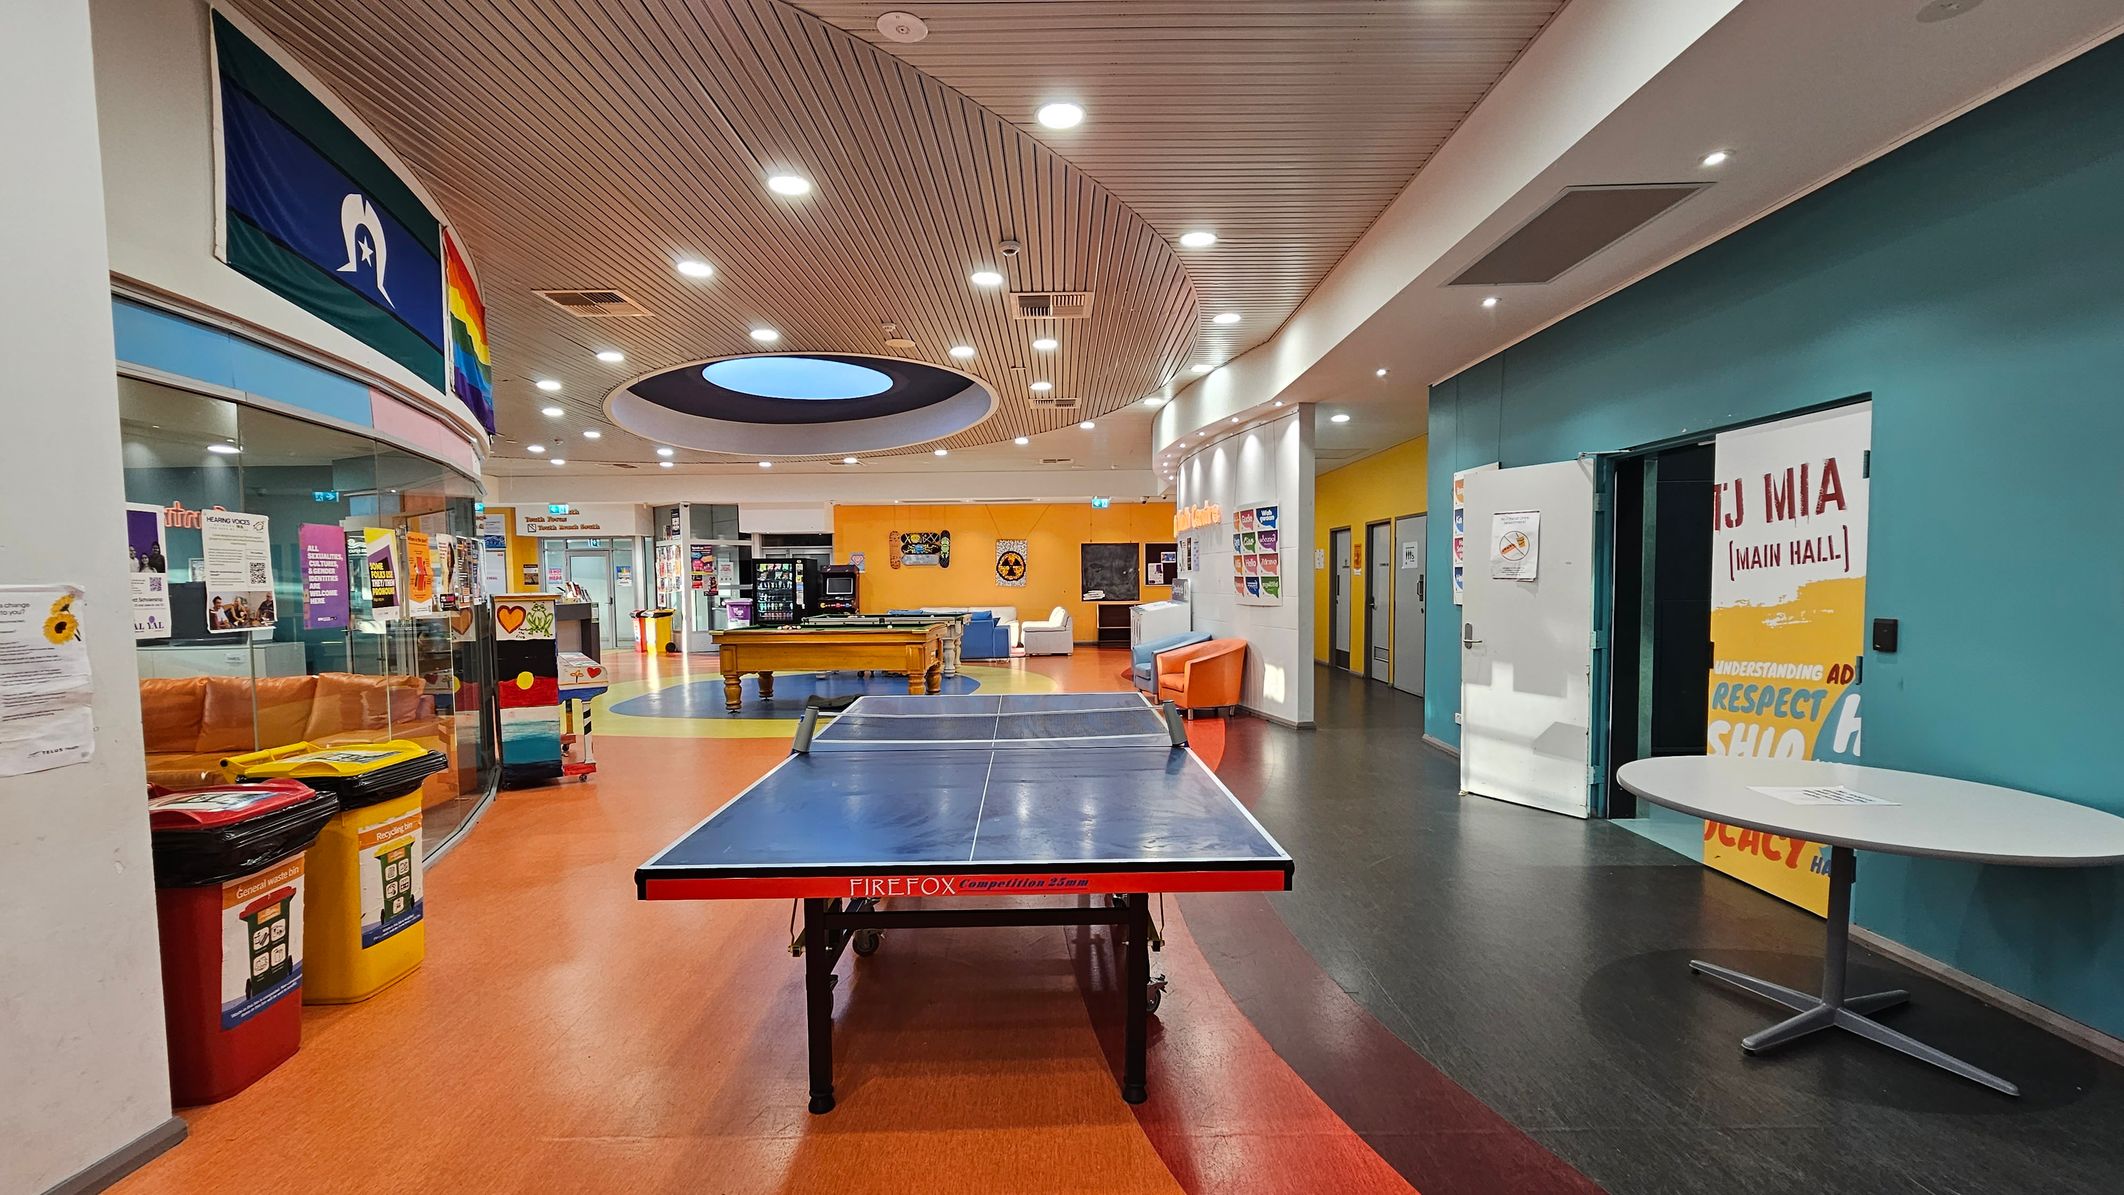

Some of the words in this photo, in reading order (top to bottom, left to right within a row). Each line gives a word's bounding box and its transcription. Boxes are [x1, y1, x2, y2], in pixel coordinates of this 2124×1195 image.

[1764, 457, 1847, 524] MIA
[232, 518, 251, 526] VOICES
[307, 553, 343, 561] SEXUALITIES,
[308, 560, 339, 569] CULTURES,
[310, 597, 326, 605] HERE
[1714, 660, 1824, 680] UNDERSTANDING
[1711, 681, 1829, 723] RESPECT
[42, 747, 64, 755] TELUS
[376, 825, 405, 842] Recycling
[404, 821, 413, 831] bin
[235, 879, 267, 899] General
[267, 870, 289, 886] waste
[289, 865, 300, 878] bin
[850, 877, 958, 897] FIREFOX
[959, 877, 1044, 890] Competition
[1048, 876, 1090, 889] 25mm
